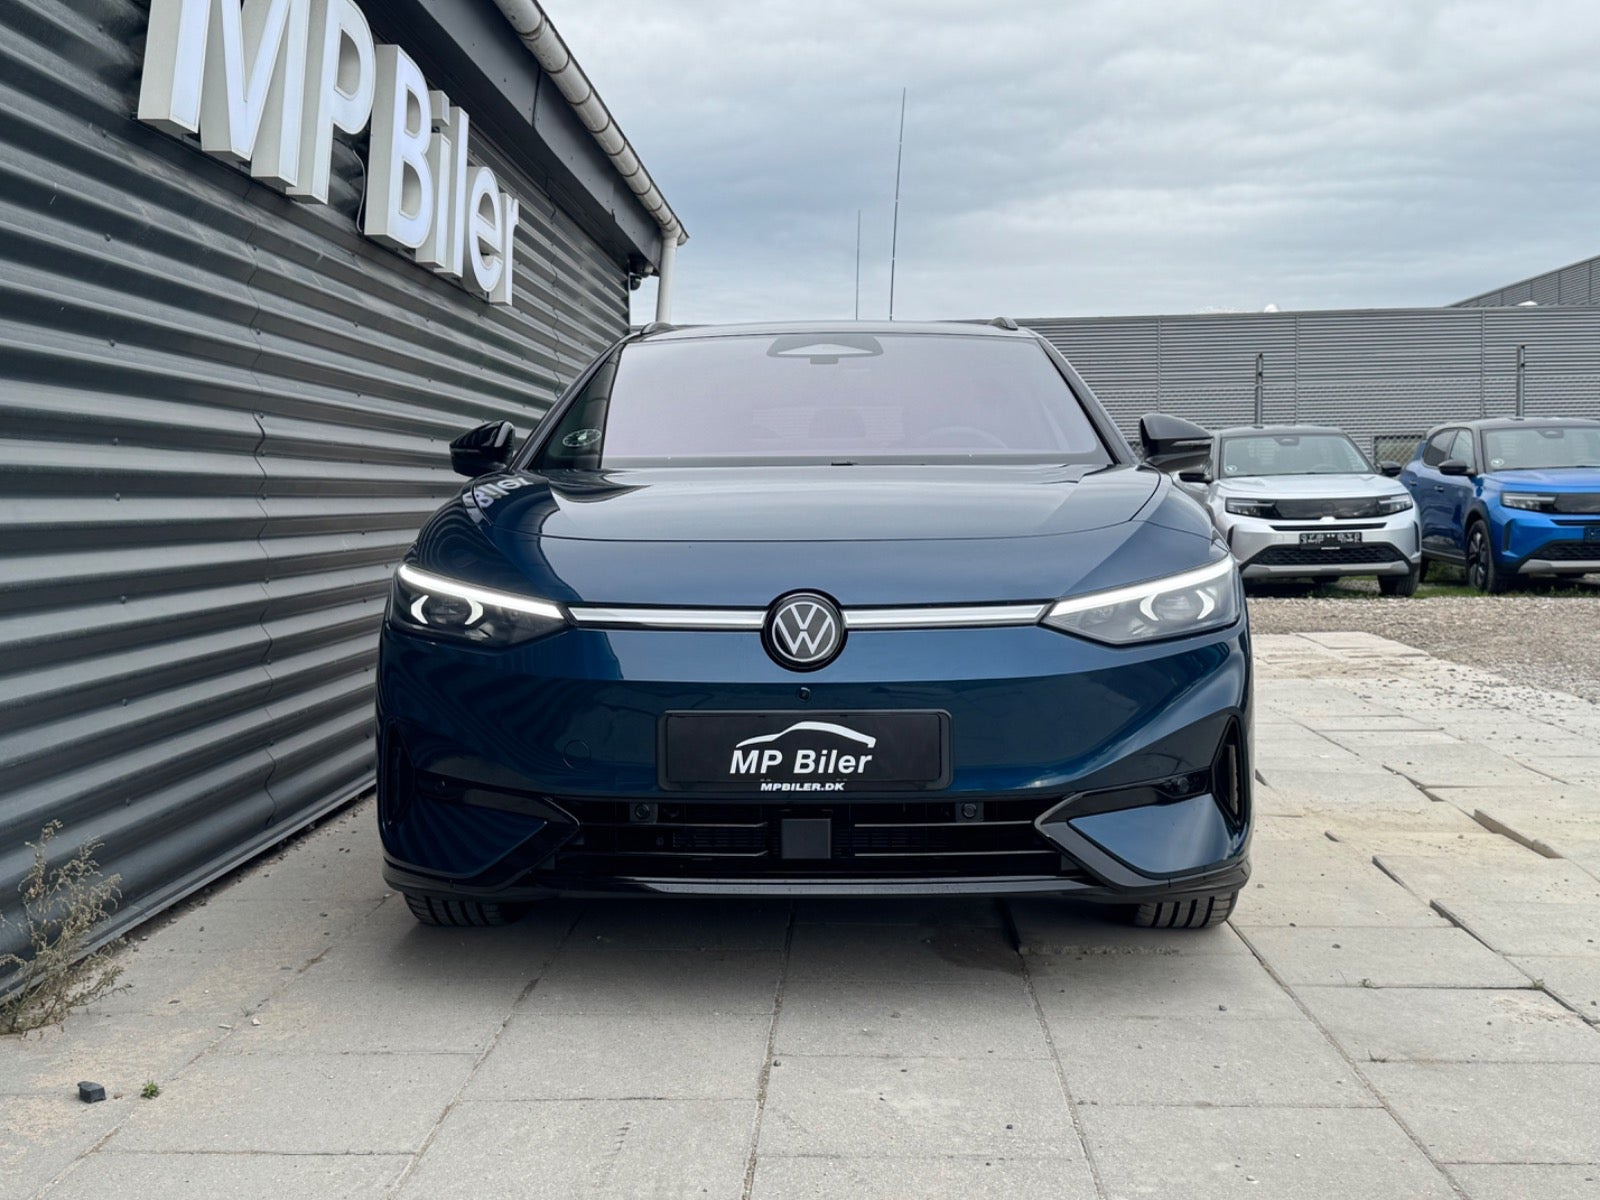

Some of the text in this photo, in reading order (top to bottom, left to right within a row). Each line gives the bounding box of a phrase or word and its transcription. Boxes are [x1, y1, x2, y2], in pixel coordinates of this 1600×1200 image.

[137, 0, 519, 306] MP Biler
[772, 601, 836, 662] VW
[729, 749, 873, 774] MP Biler
[760, 782, 845, 792] MPBILER.DK
